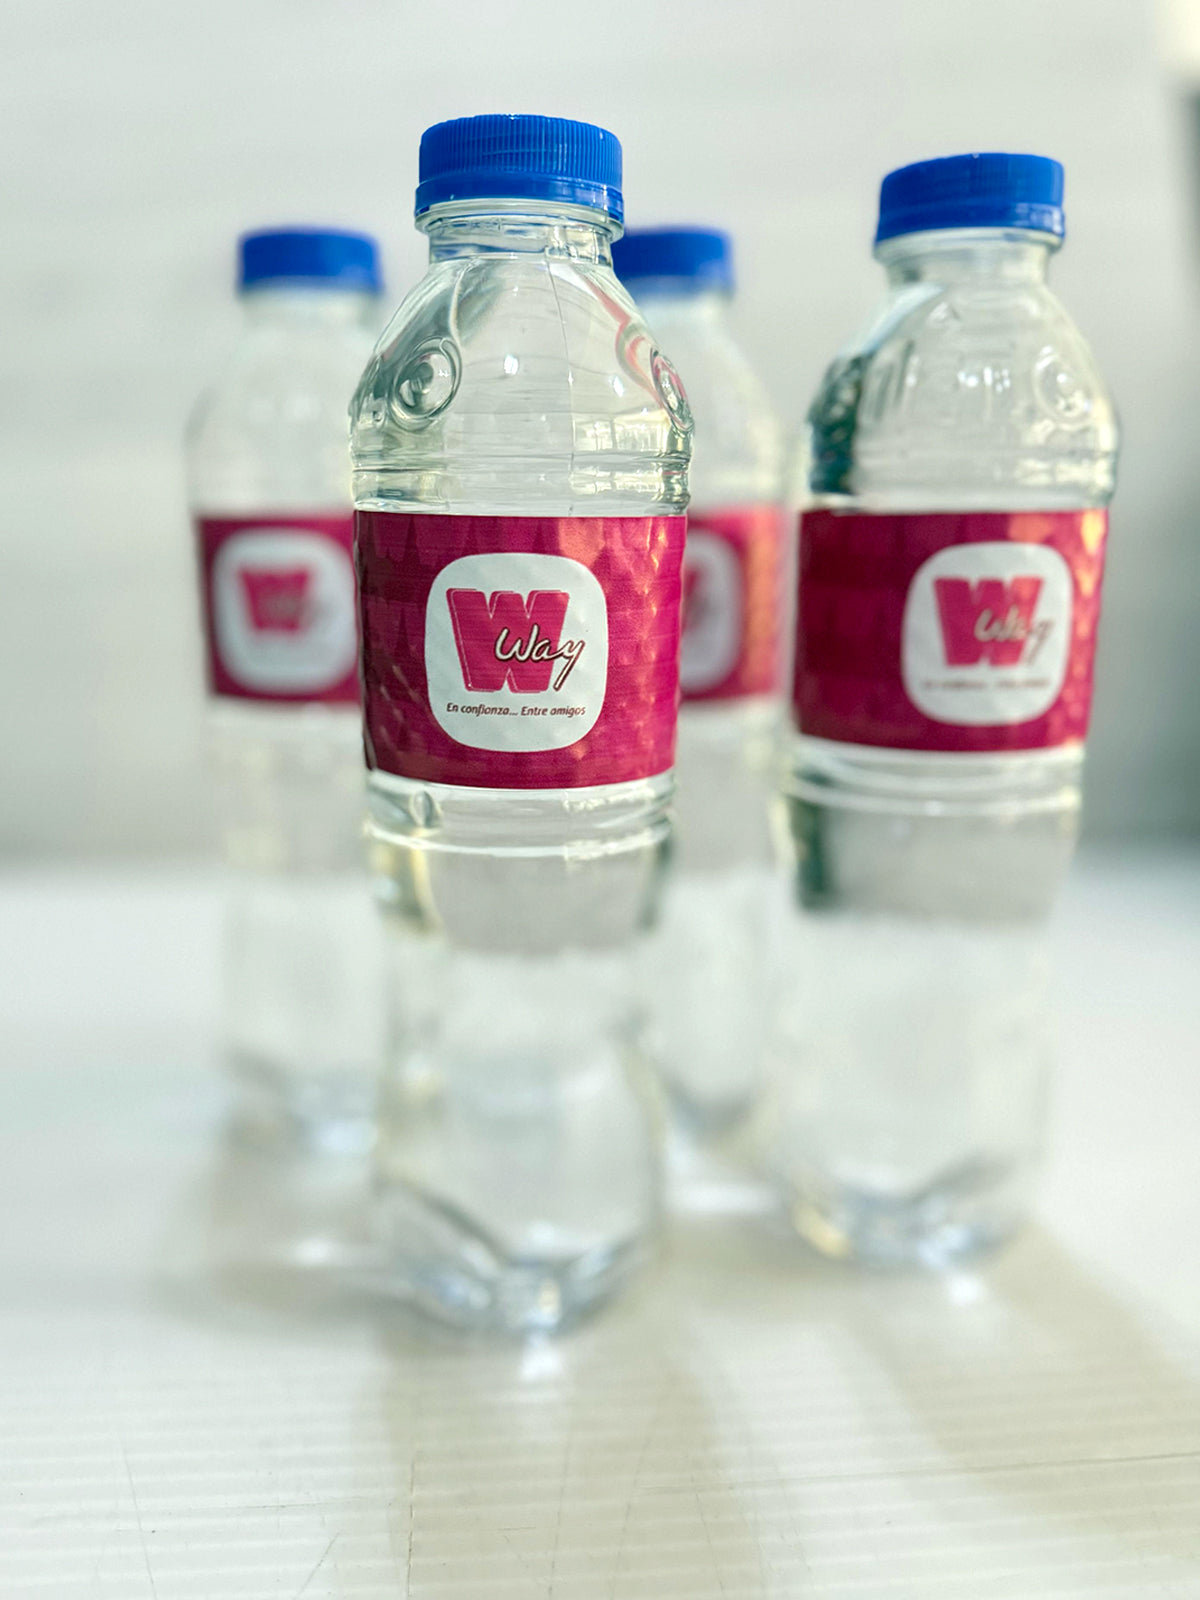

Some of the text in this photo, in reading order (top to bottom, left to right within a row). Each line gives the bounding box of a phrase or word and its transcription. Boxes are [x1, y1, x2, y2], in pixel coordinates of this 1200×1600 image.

[446, 588, 570, 693] W
[494, 623, 586, 692] Way
[933, 576, 1043, 668] W
[446, 702, 459, 712] En
[520, 706, 548, 716] Entre
[549, 705, 586, 718] amigos
